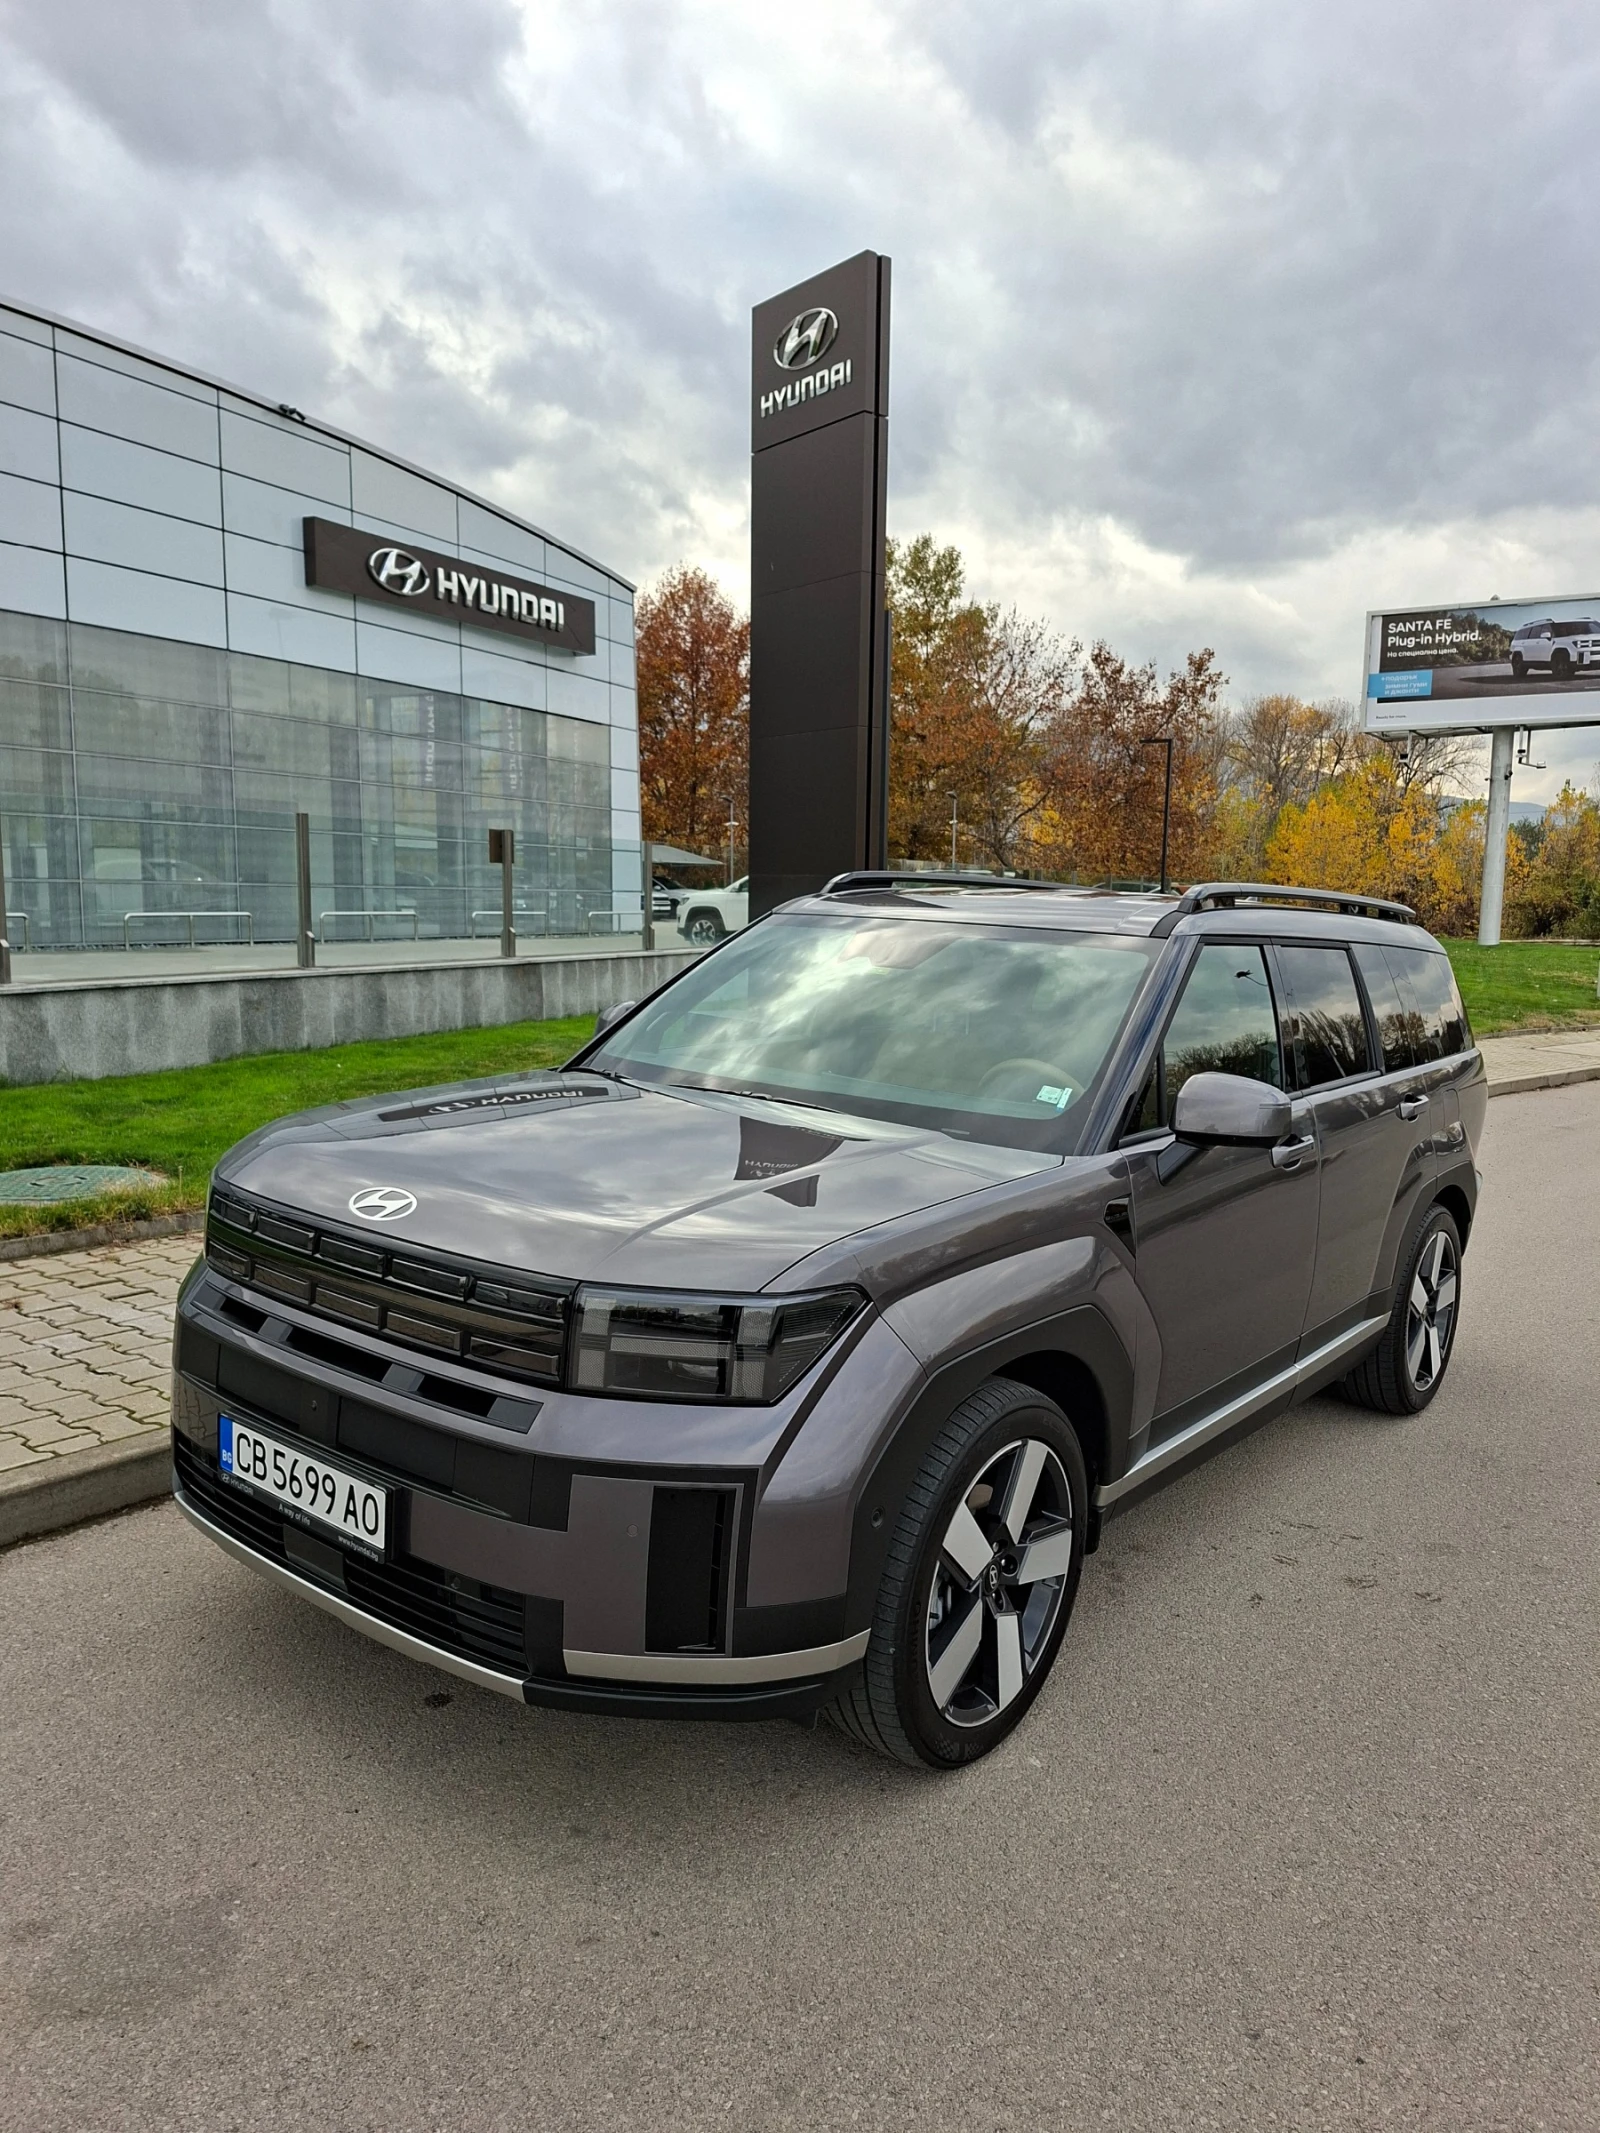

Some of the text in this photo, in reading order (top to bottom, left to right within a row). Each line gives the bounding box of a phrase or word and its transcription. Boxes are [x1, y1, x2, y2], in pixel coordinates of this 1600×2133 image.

[760, 359, 852, 418] HYUNDAI
[436, 567, 564, 632] HYUNDAI
[1388, 619, 1452, 633] SANTA FE
[1387, 630, 1482, 648] Plug-in Hybrid.
[222, 1449, 232, 1464] BG
[279, 1503, 283, 1512] A
[284, 1508, 294, 1519] way
[302, 1516, 310, 1526] life
